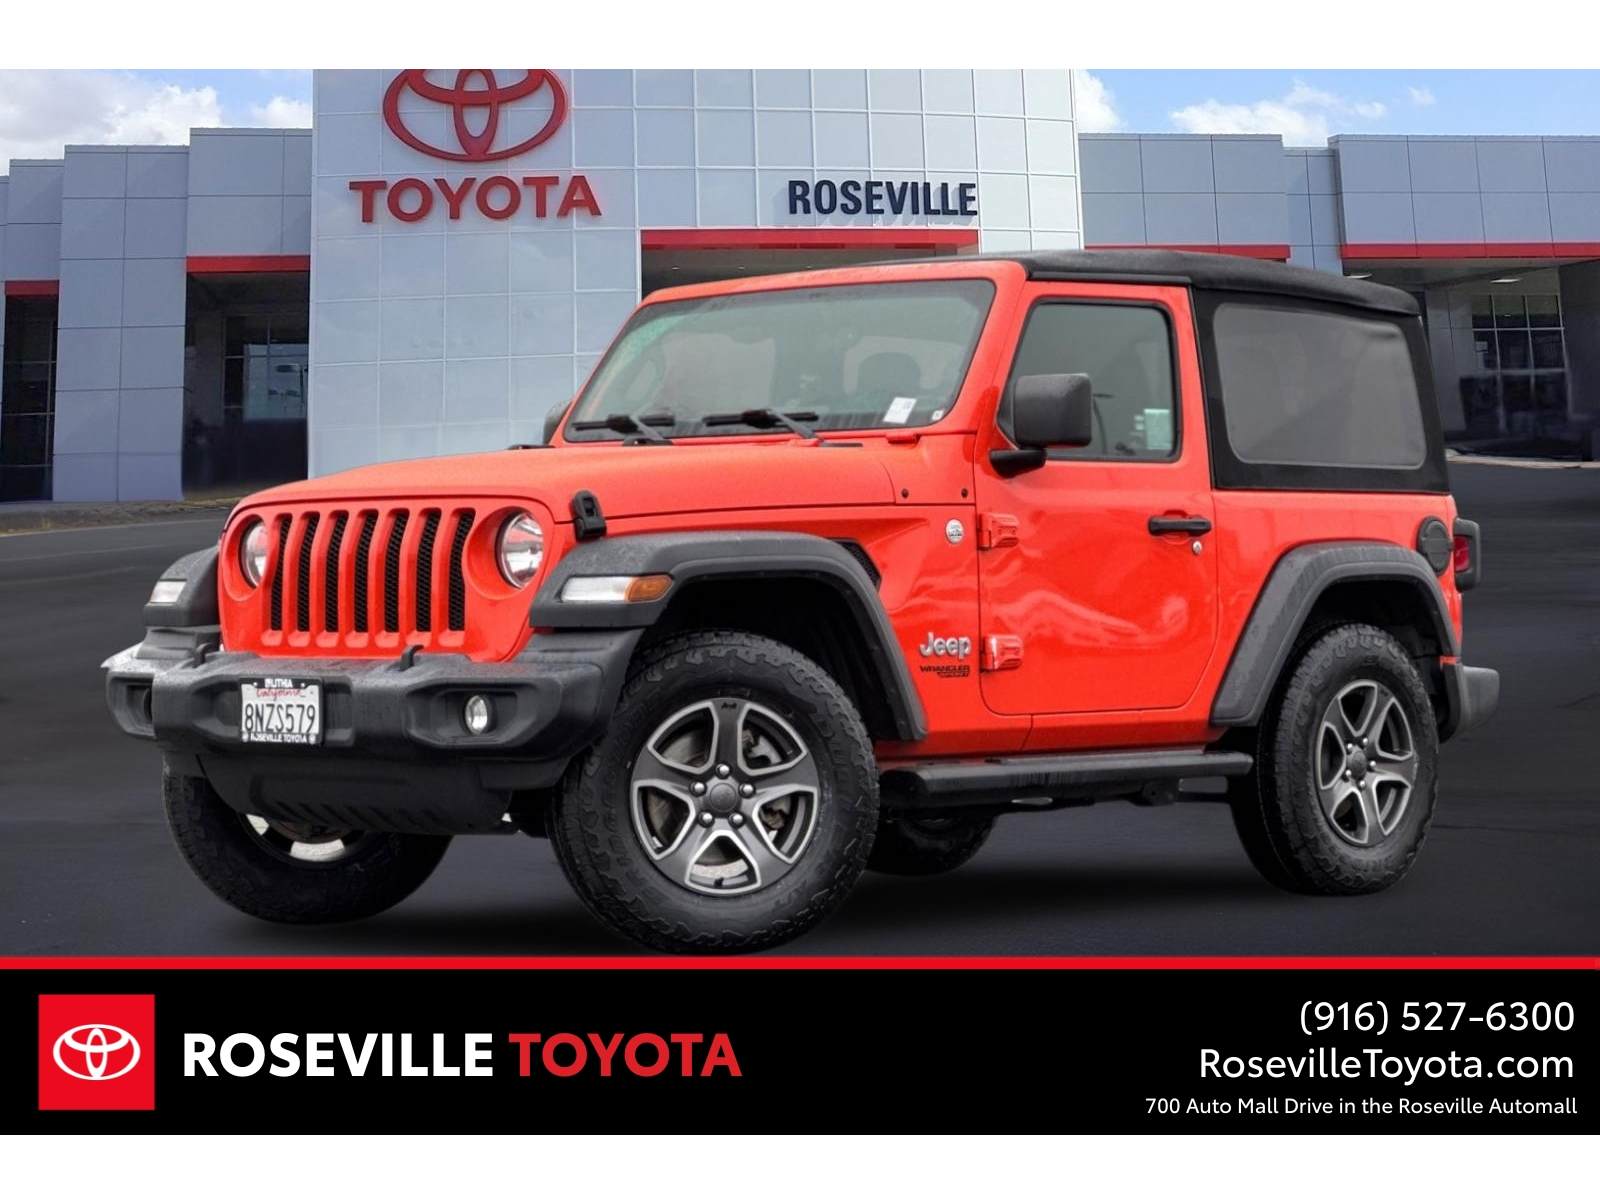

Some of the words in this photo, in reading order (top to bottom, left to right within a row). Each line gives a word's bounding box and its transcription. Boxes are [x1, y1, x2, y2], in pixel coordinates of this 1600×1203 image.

[349, 175, 602, 222] TOYOTA
[788, 180, 979, 217] ROSEVILLE
[919, 631, 971, 659] Jeep
[244, 703, 316, 733] 8NZS579
